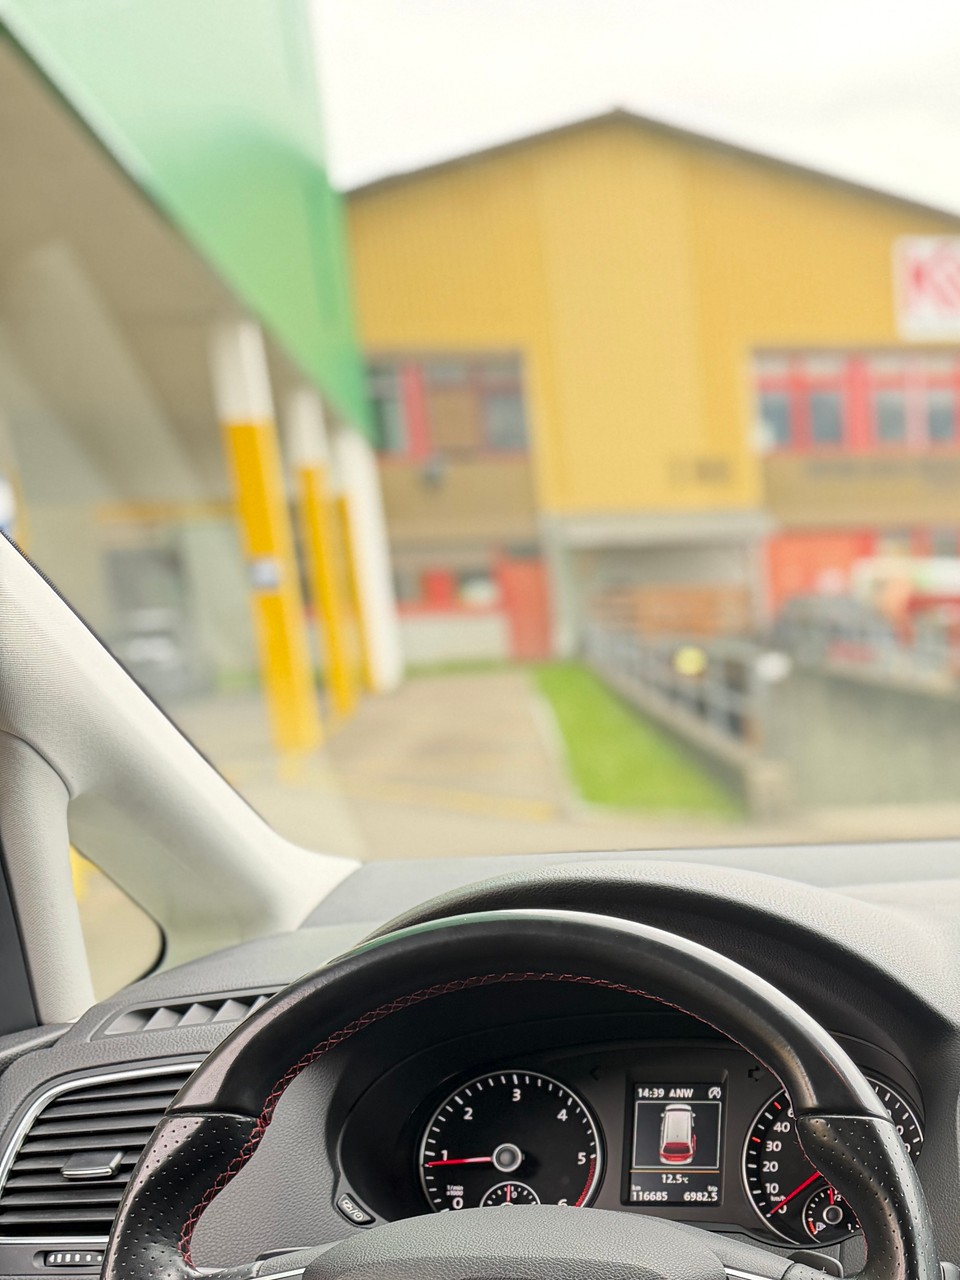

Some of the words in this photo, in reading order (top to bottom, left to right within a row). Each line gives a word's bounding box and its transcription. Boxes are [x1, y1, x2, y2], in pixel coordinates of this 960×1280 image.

[512, 1089, 521, 1101] 3
[637, 1088, 665, 1098] 14:39
[669, 1089, 694, 1098] ANW
[463, 1108, 473, 1120] 2
[557, 1109, 568, 1122] 4
[773, 1121, 791, 1133] 40
[765, 1141, 782, 1152] 30
[441, 1150, 448, 1161] 1
[577, 1151, 586, 1165] 5
[762, 1161, 779, 1172] 20
[765, 1183, 779, 1194] 10
[632, 1192, 668, 1200] 116685
[683, 1192, 718, 1201] 6982.5
[452, 1197, 463, 1210] 0
